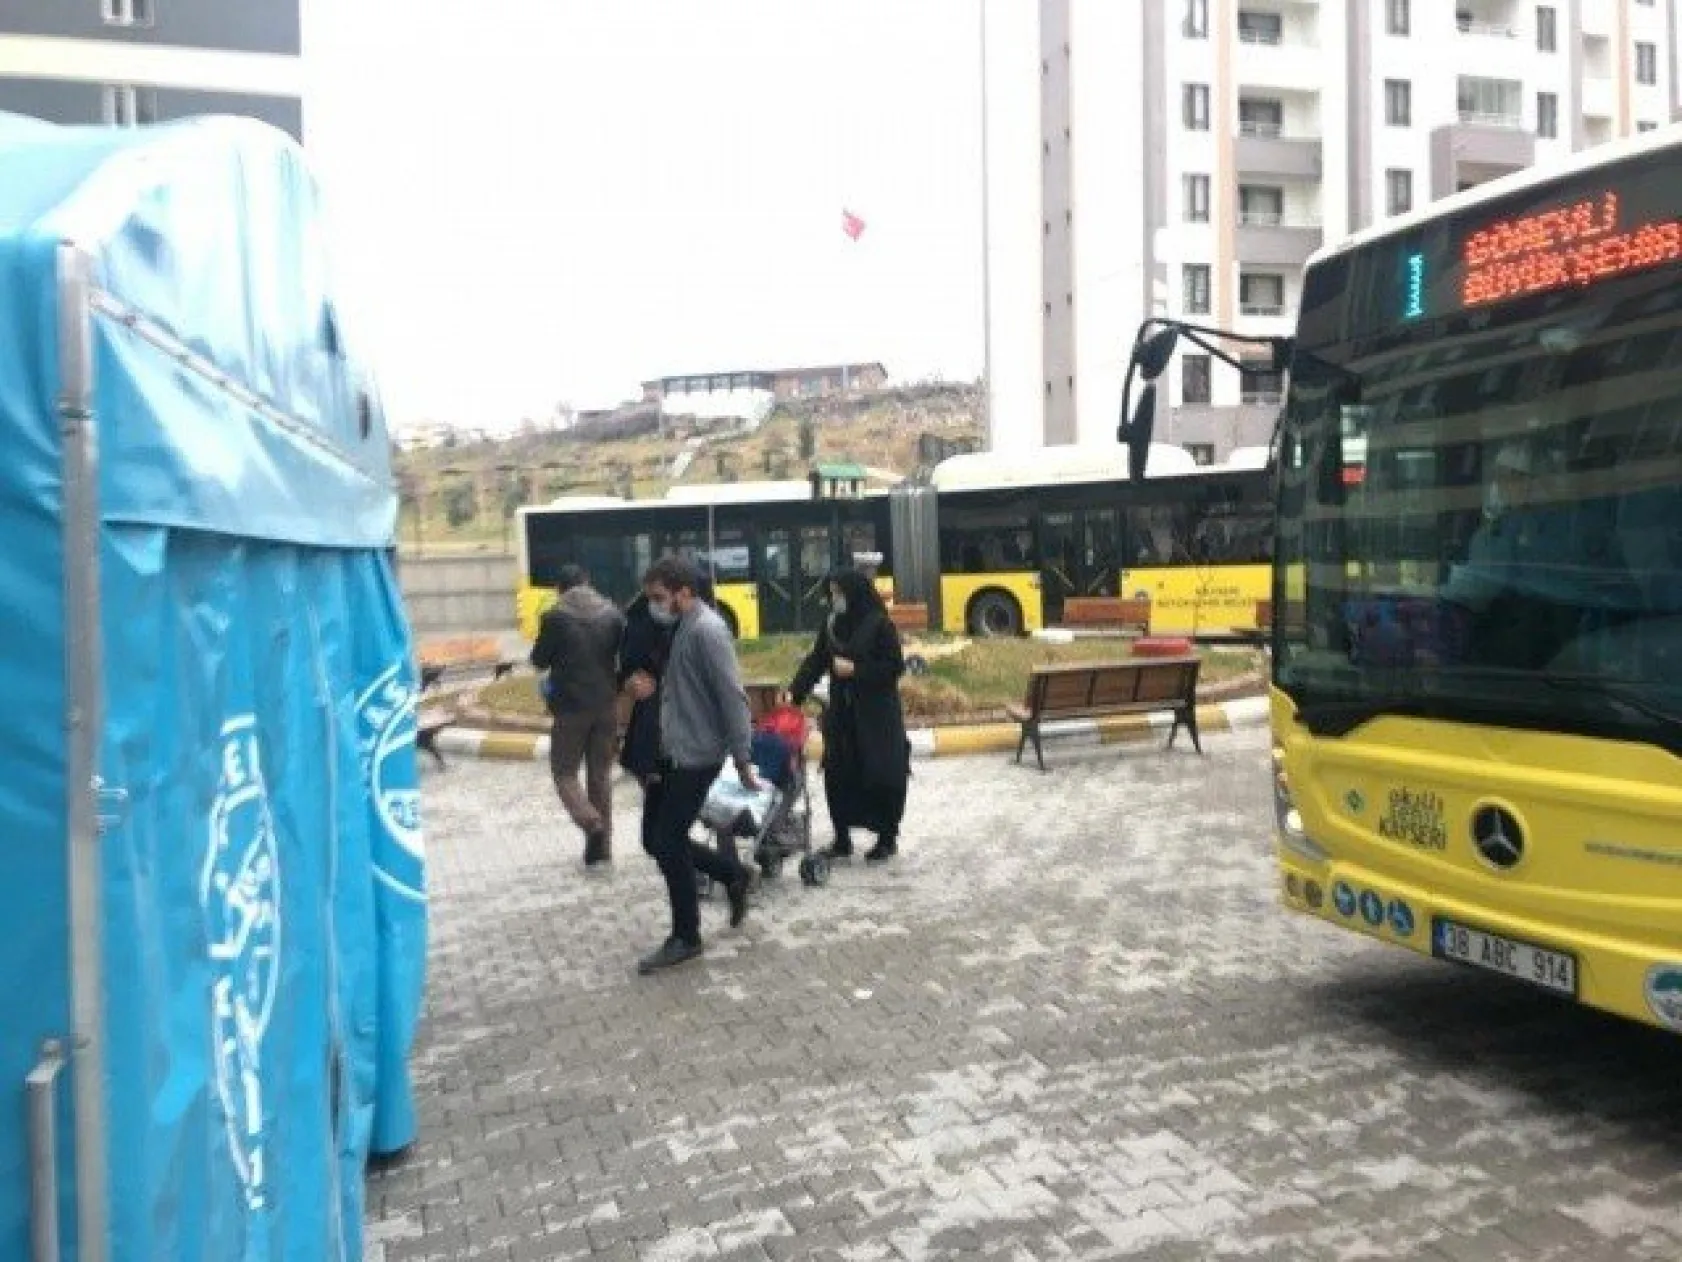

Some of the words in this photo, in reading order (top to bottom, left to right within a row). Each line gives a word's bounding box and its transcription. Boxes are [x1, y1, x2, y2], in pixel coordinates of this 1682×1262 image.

[1447, 924, 1469, 957] 38
[1481, 937, 1518, 971] ABC
[1533, 950, 1568, 987] 914
